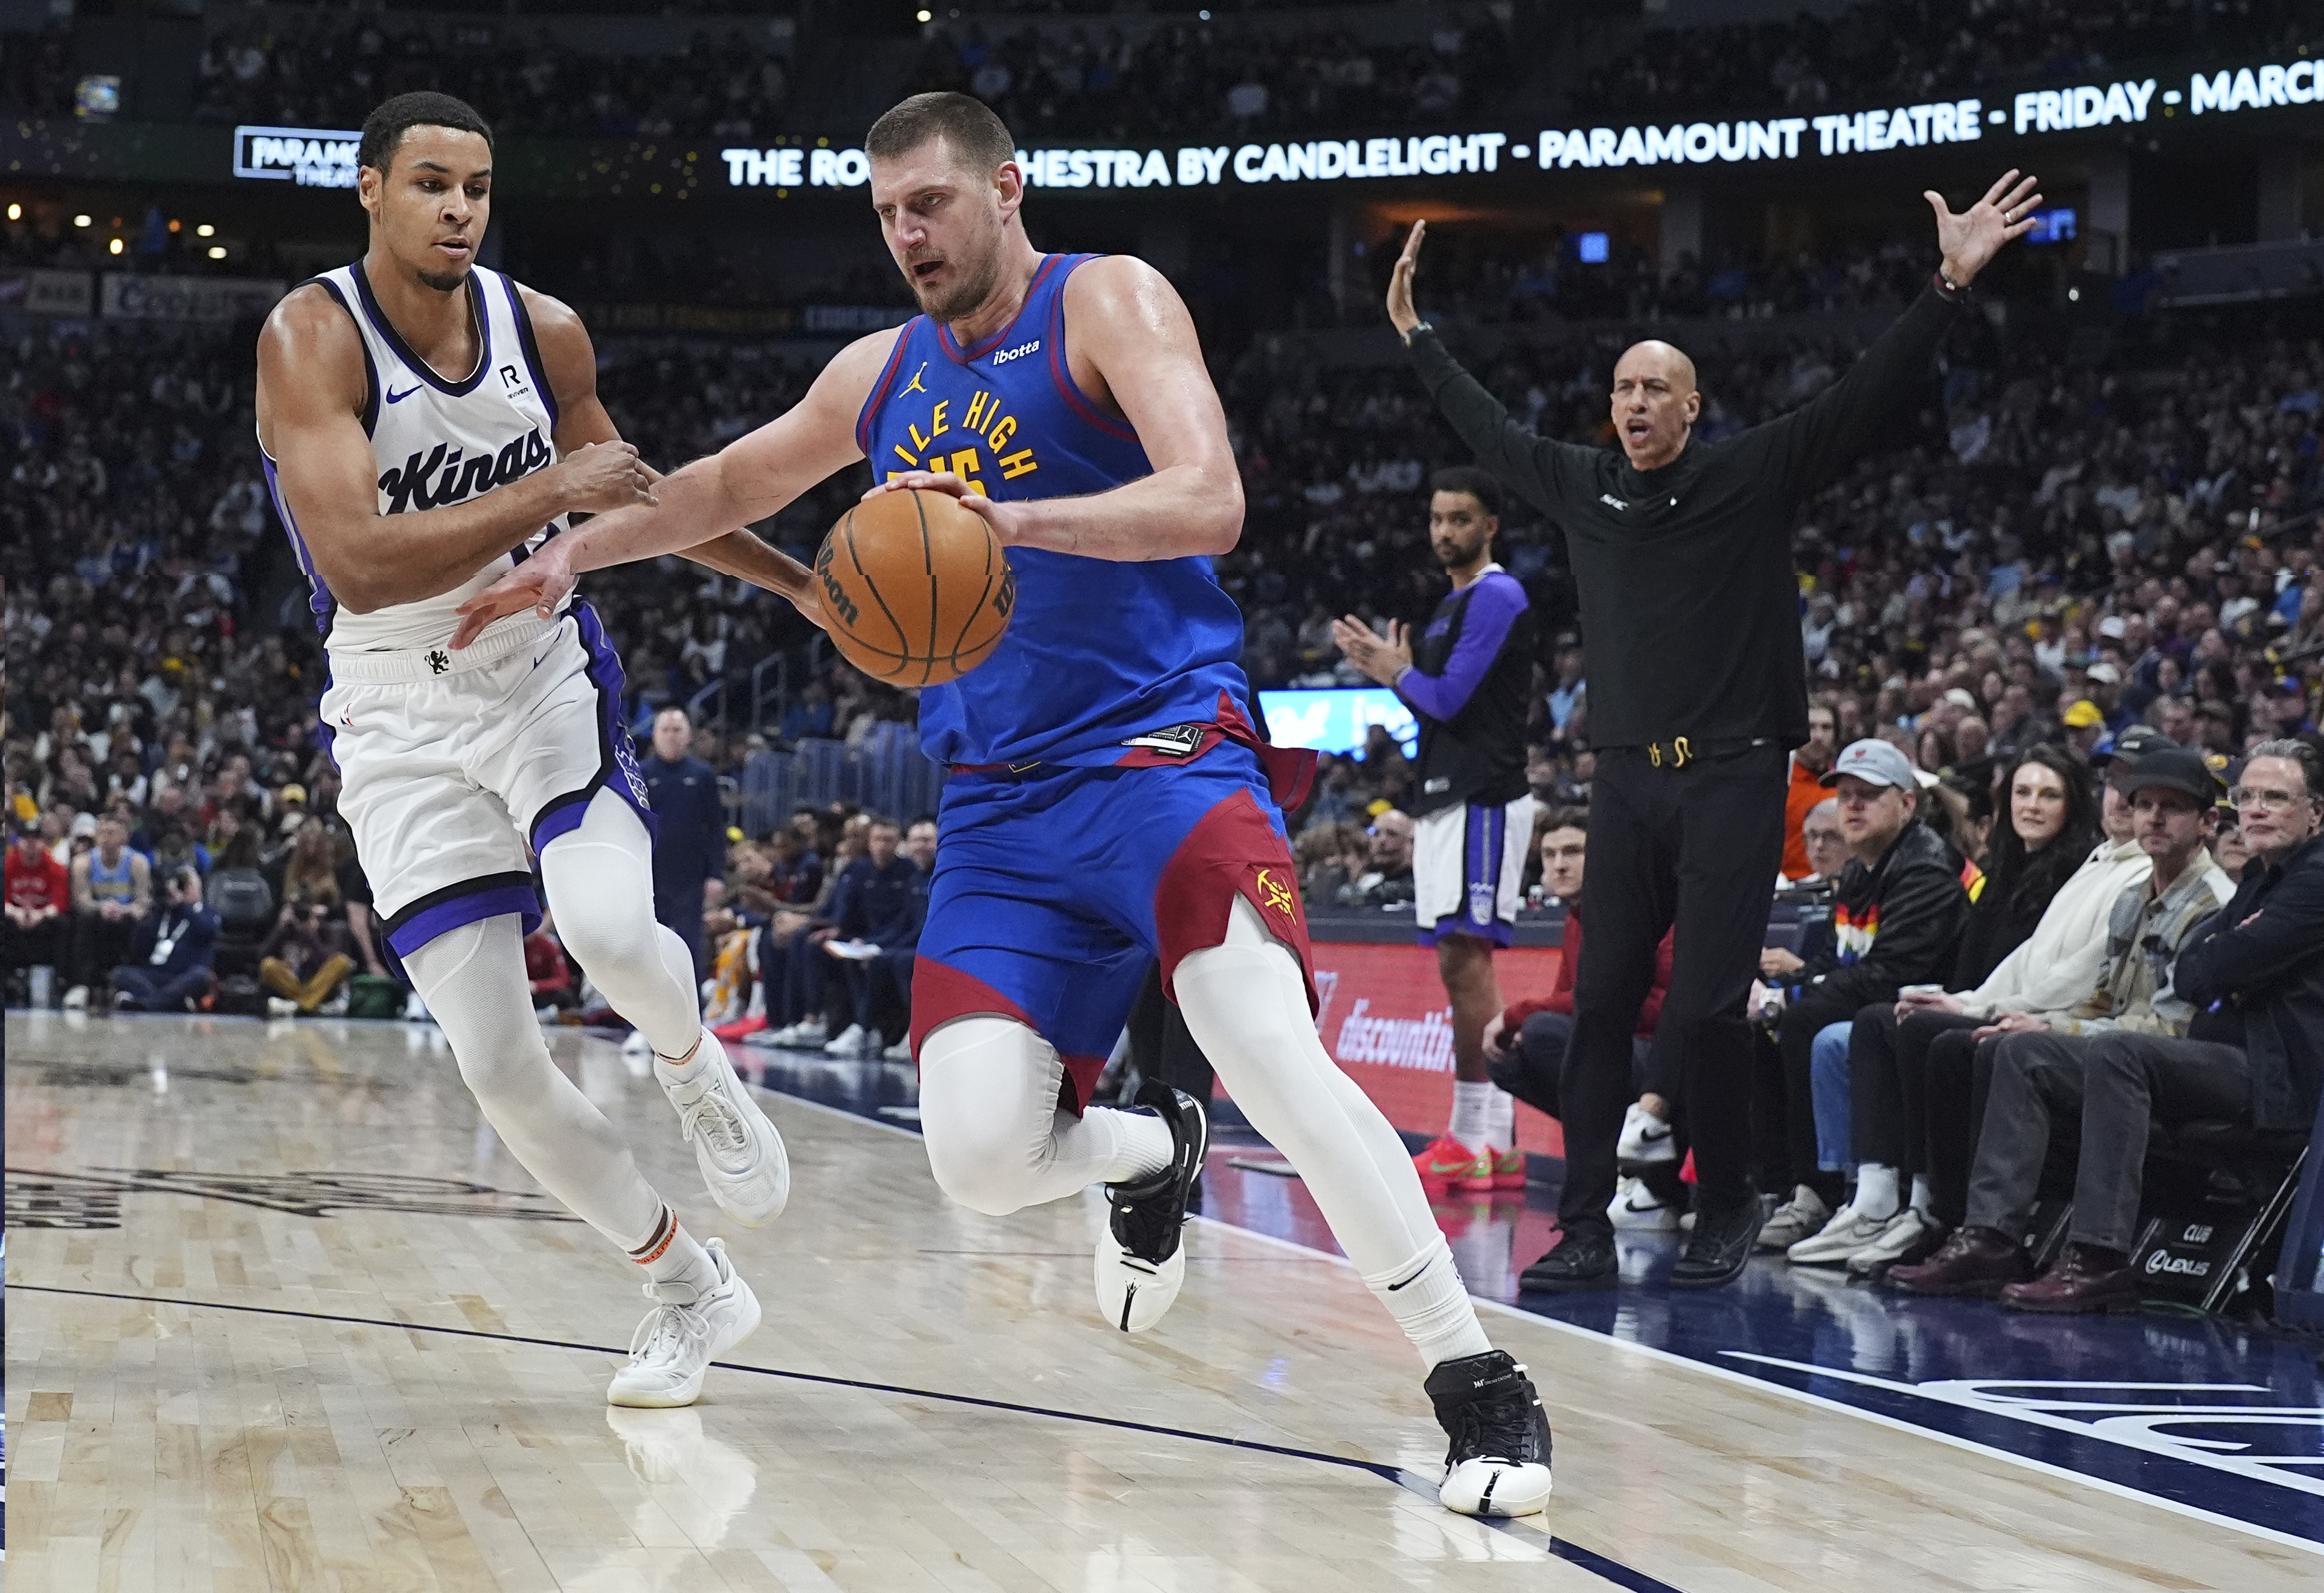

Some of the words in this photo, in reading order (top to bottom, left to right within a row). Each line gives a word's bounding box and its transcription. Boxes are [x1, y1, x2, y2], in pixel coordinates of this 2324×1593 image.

[721, 149, 804, 187] THE
[1015, 149, 1172, 187] HESTRA
[1176, 146, 1230, 186] BY
[1233, 132, 1507, 183] CANDLELIGHT
[1538, 118, 1808, 170] PARAMOUNT
[1812, 98, 1982, 156] THEATRE
[2014, 79, 2157, 135] FRIDAY
[251, 137, 361, 169] PARAM
[993, 340, 1040, 365] ibotta
[499, 365, 521, 388] R
[887, 399, 949, 481] ILE
[962, 390, 1038, 481] HIGH
